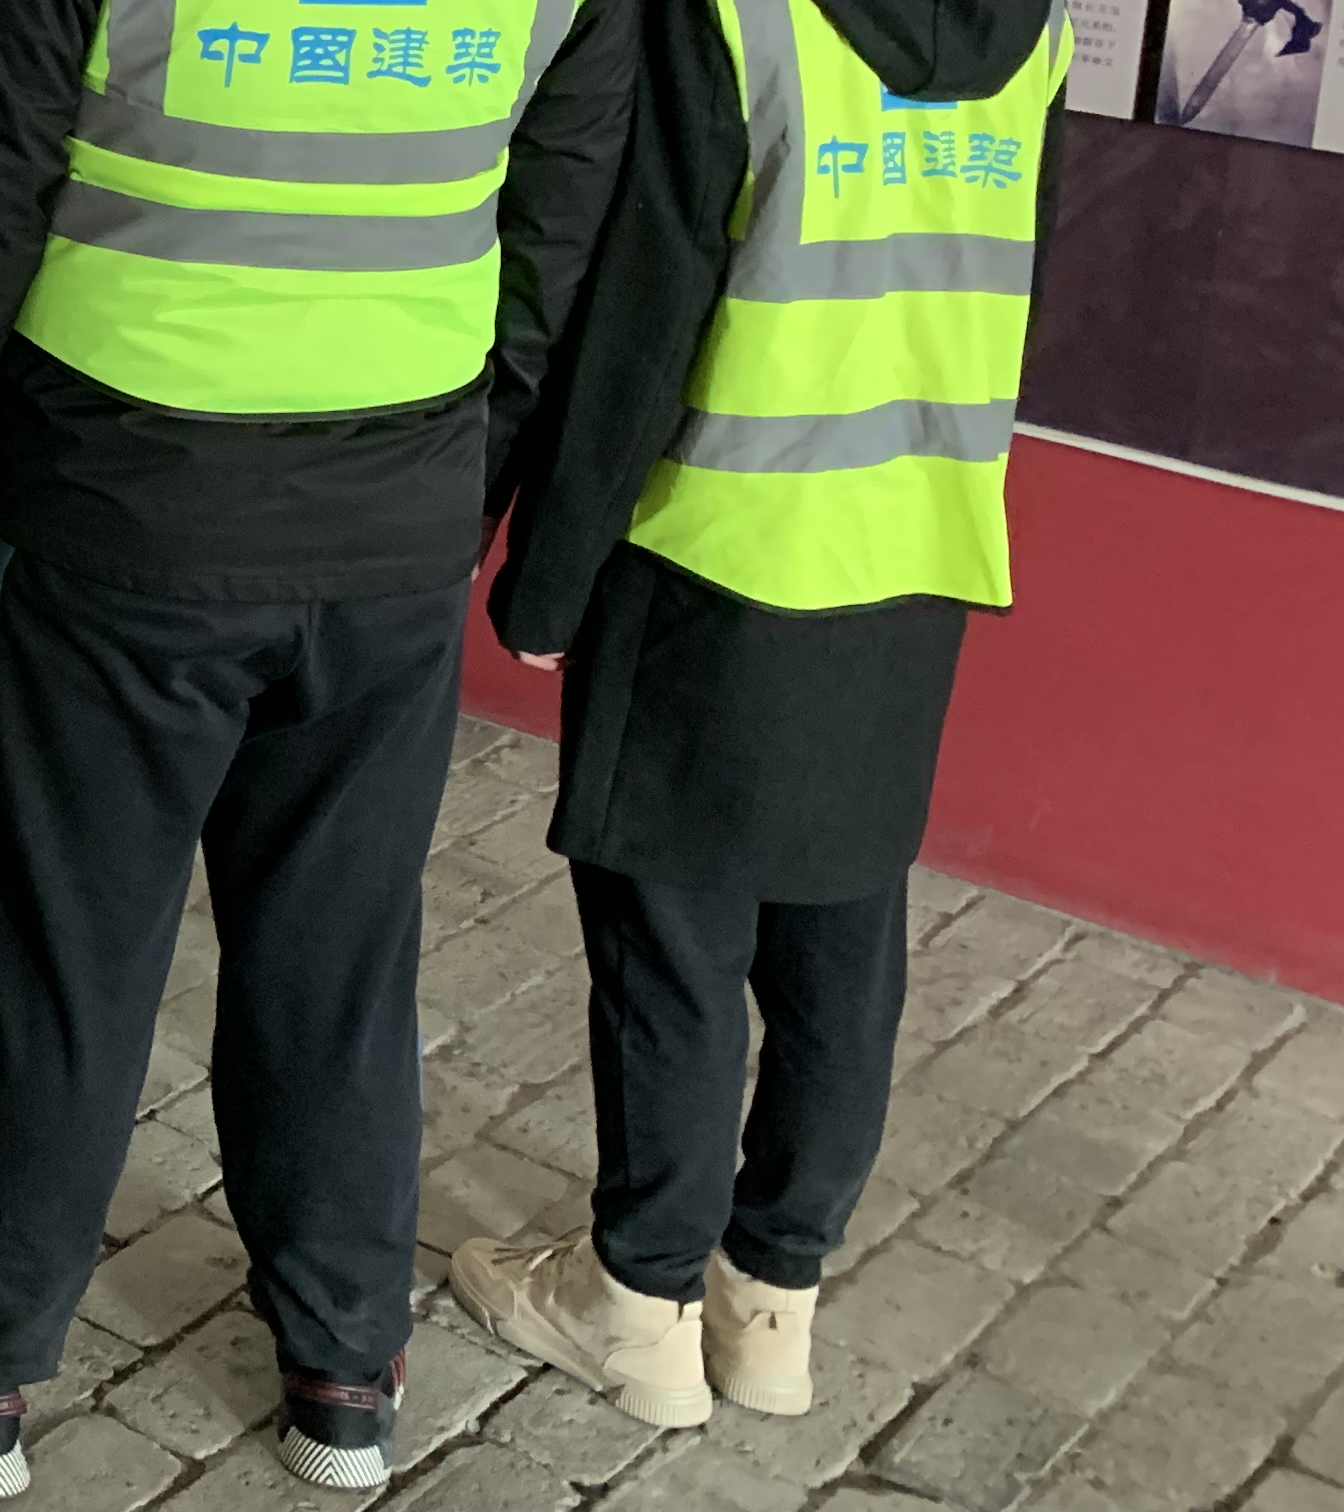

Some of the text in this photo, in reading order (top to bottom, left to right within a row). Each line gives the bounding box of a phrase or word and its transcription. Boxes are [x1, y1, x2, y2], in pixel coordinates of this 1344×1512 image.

[197, 21, 502, 88] 中國建築
[817, 130, 1023, 199] 中國建築
